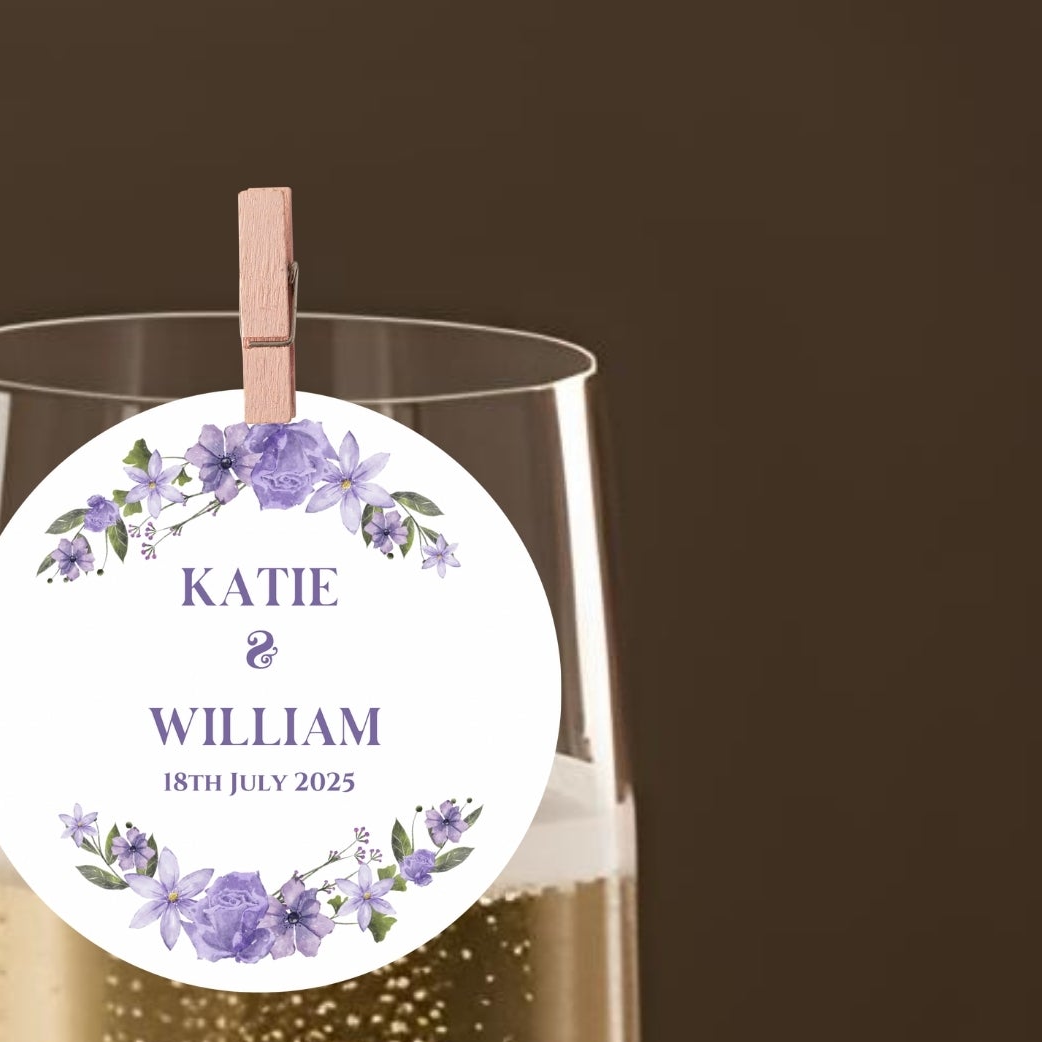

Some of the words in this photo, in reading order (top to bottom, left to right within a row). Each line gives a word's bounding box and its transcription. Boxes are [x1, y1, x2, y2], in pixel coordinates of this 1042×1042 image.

[181, 567, 339, 607] KATIE
[245, 629, 279, 670] &
[148, 707, 382, 746] WILLIAM
[164, 771, 222, 792] 18TH
[229, 772, 288, 797] JULY
[294, 771, 356, 793] 2025
